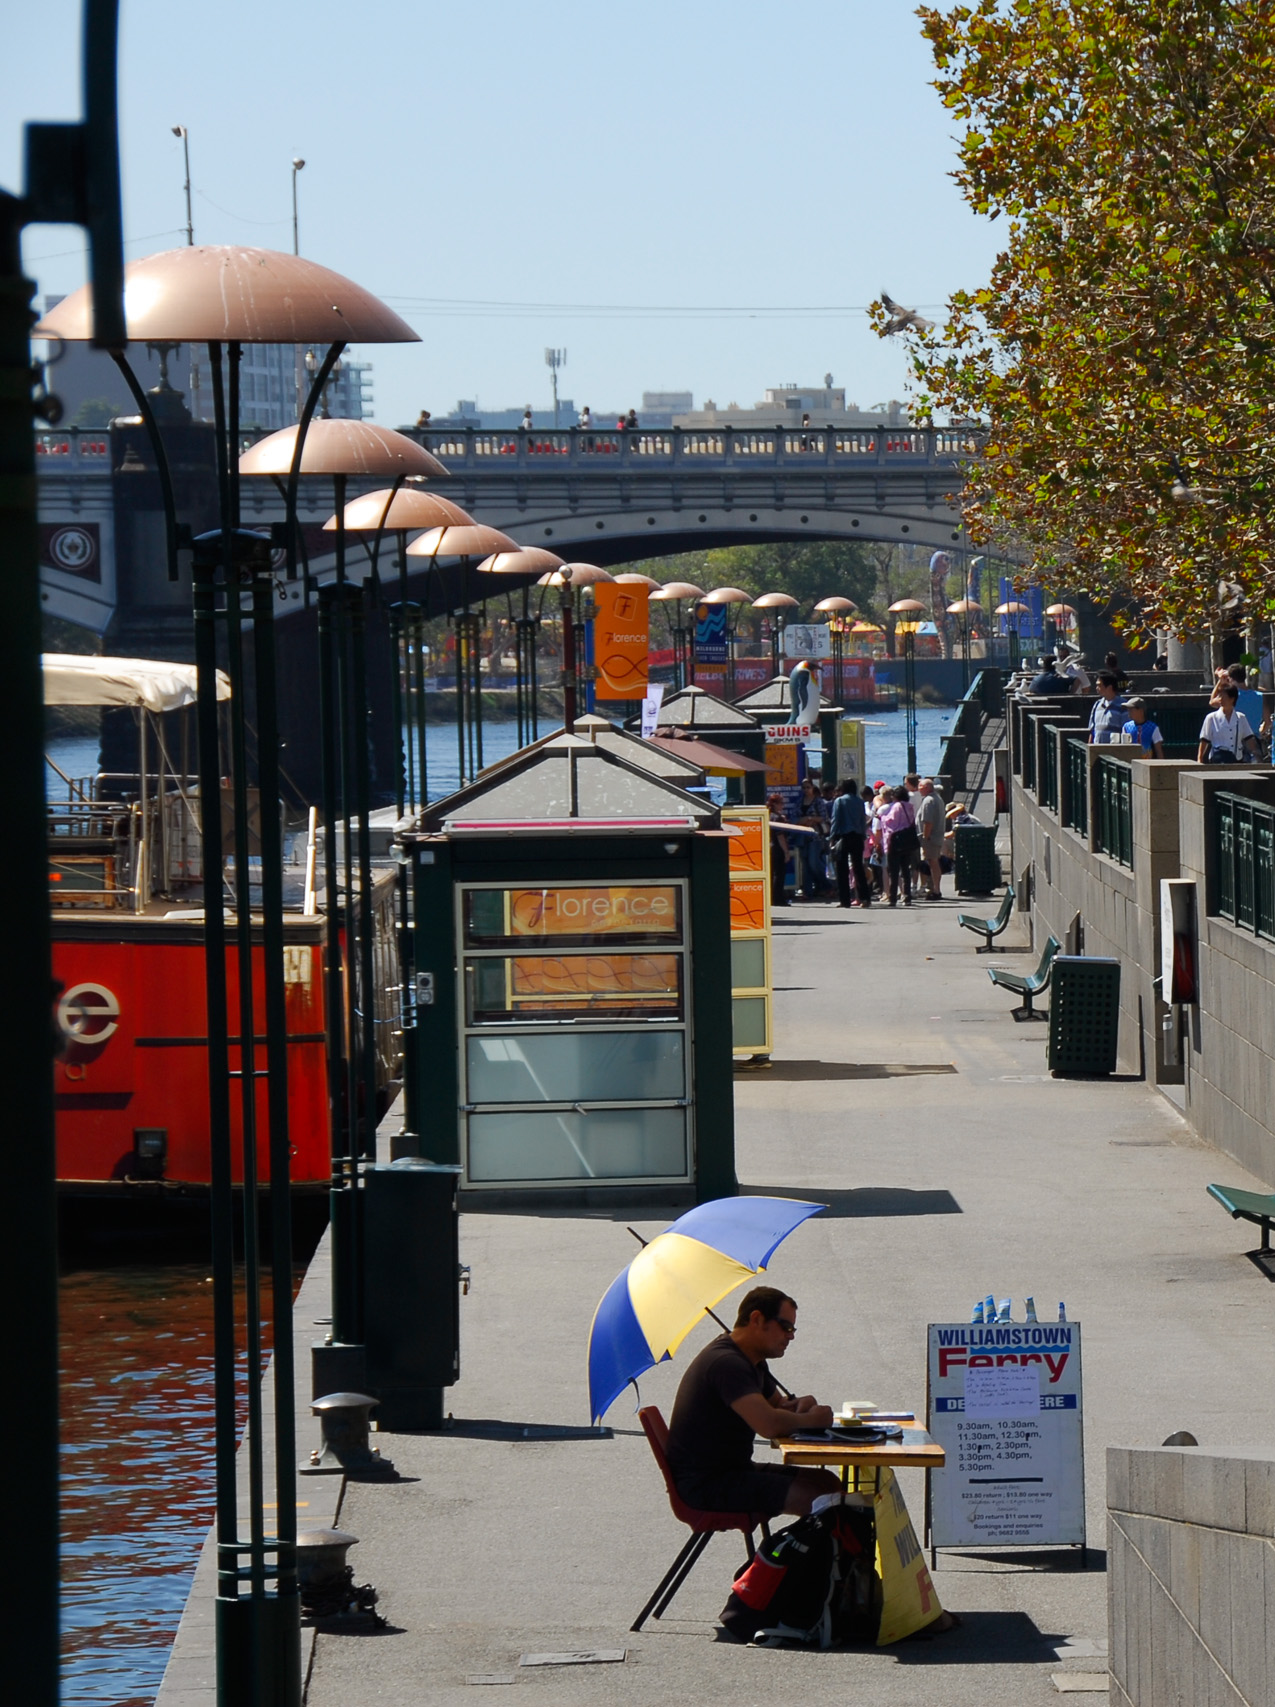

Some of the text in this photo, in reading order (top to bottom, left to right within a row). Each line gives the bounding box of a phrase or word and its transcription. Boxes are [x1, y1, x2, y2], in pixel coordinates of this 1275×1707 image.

[601, 632, 647, 646] Florence
[512, 891, 669, 928] Florence
[938, 1328, 1072, 1346] WILLIAMSTOWN
[938, 1347, 1070, 1383] Ferry
[957, 1421, 1038, 1431] 9.30am, 10.30am,
[958, 1432, 998, 1440] 11.30am,
[996, 1441, 1032, 1450] 2.30pm,
[959, 1452, 1033, 1462] 3.30pm, 4.30pm,
